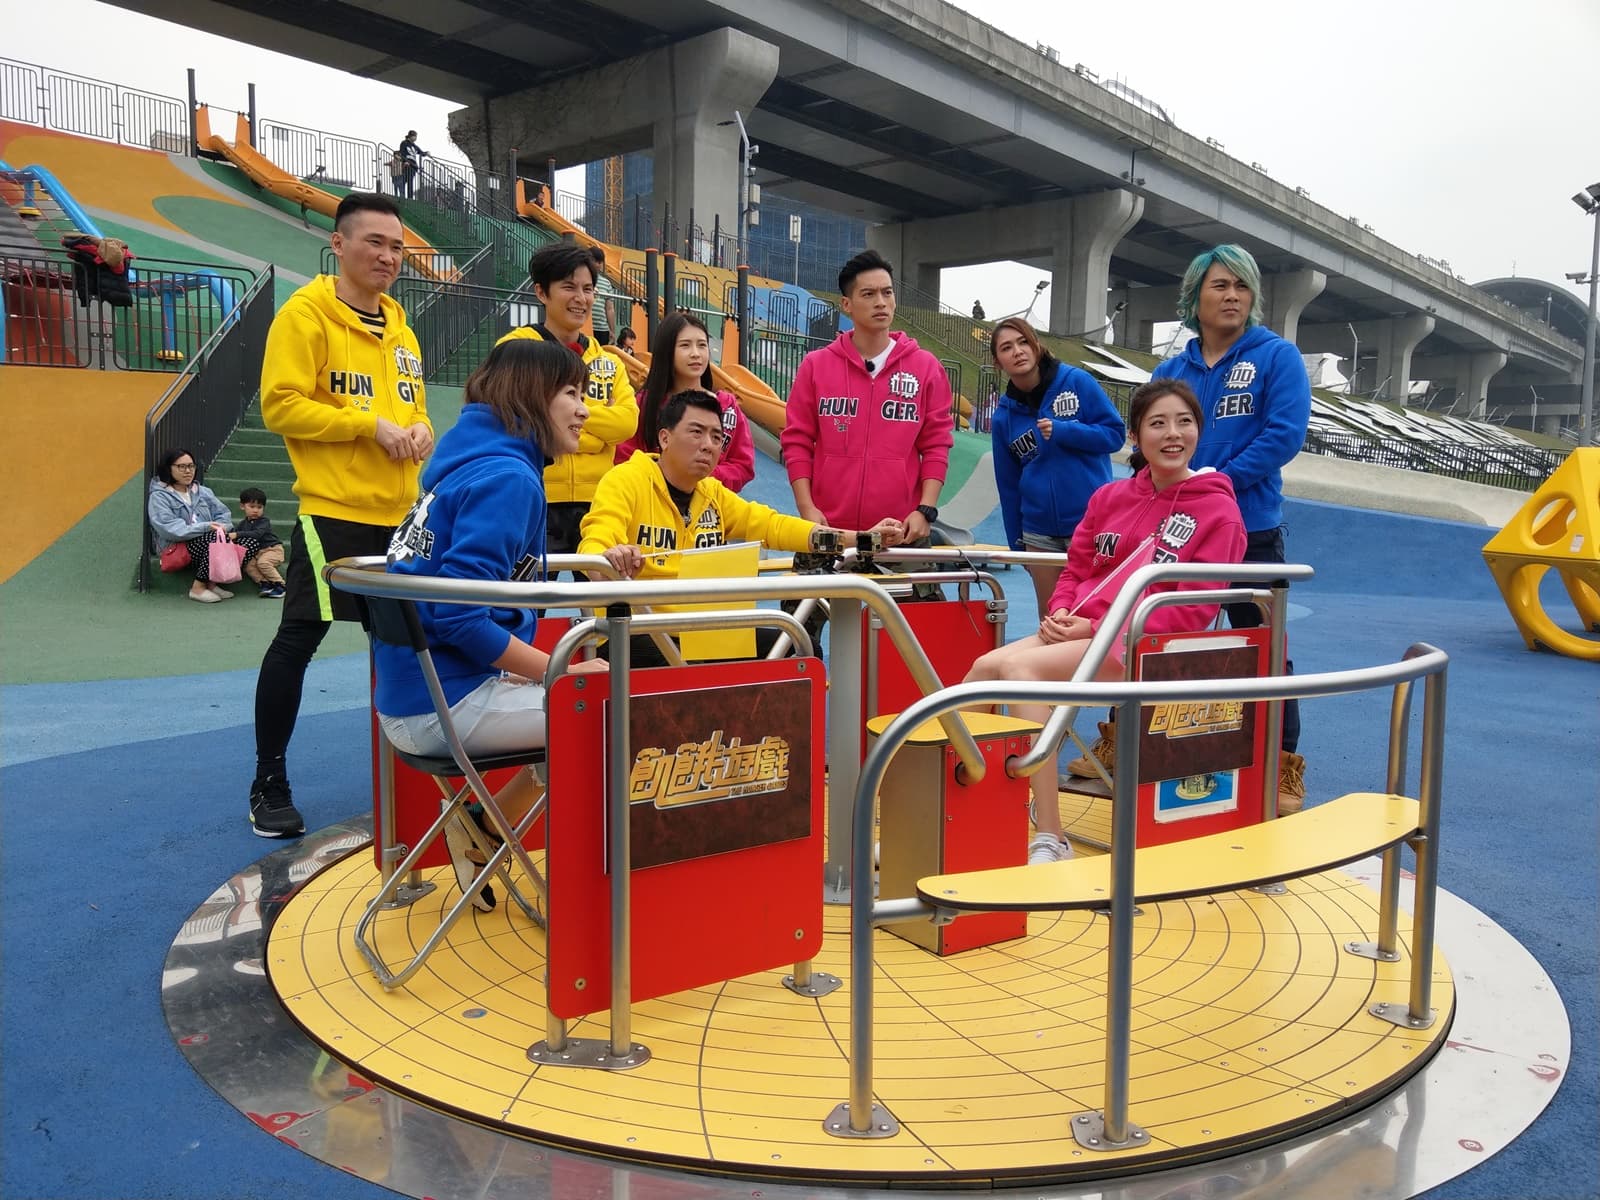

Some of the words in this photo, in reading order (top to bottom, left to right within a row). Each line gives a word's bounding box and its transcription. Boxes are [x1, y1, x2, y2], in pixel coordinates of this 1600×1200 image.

[330, 371, 374, 398] HUN
[819, 397, 858, 417] HUN
[881, 400, 919, 422] GER.
[1056, 398, 1077, 413] 100
[636, 524, 677, 551] HUN
[1166, 520, 1193, 541] 100
